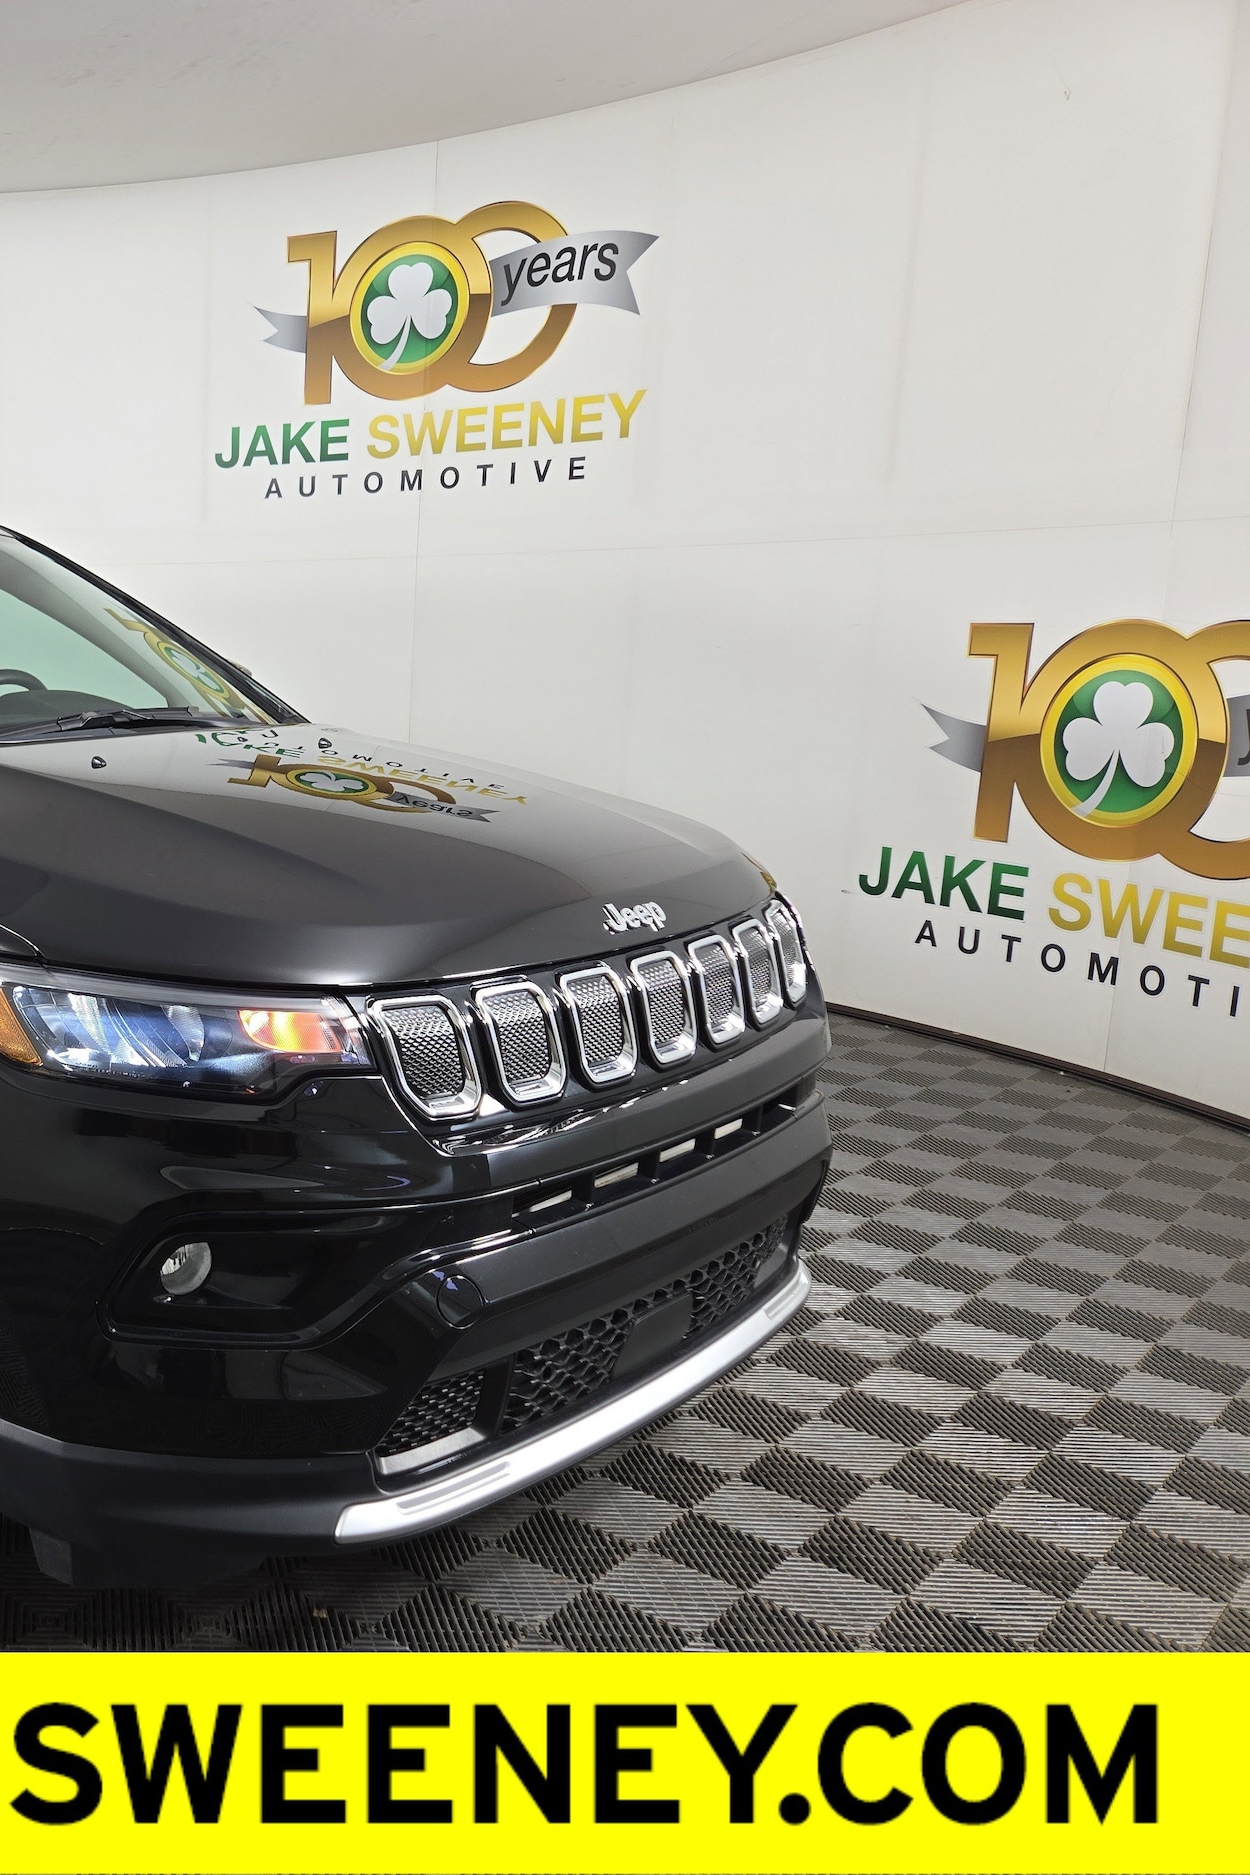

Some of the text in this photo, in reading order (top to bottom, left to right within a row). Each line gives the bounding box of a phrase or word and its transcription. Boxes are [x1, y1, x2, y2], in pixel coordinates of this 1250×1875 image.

[287, 200, 619, 405] 100 years
[215, 388, 647, 469] JAKE SWEENEY
[264, 456, 586, 499] AUTOMOTIVE
[602, 902, 667, 935] Jeep
[858, 846, 1030, 922] JAKE
[914, 919, 1241, 1018] AUTOMOTI
